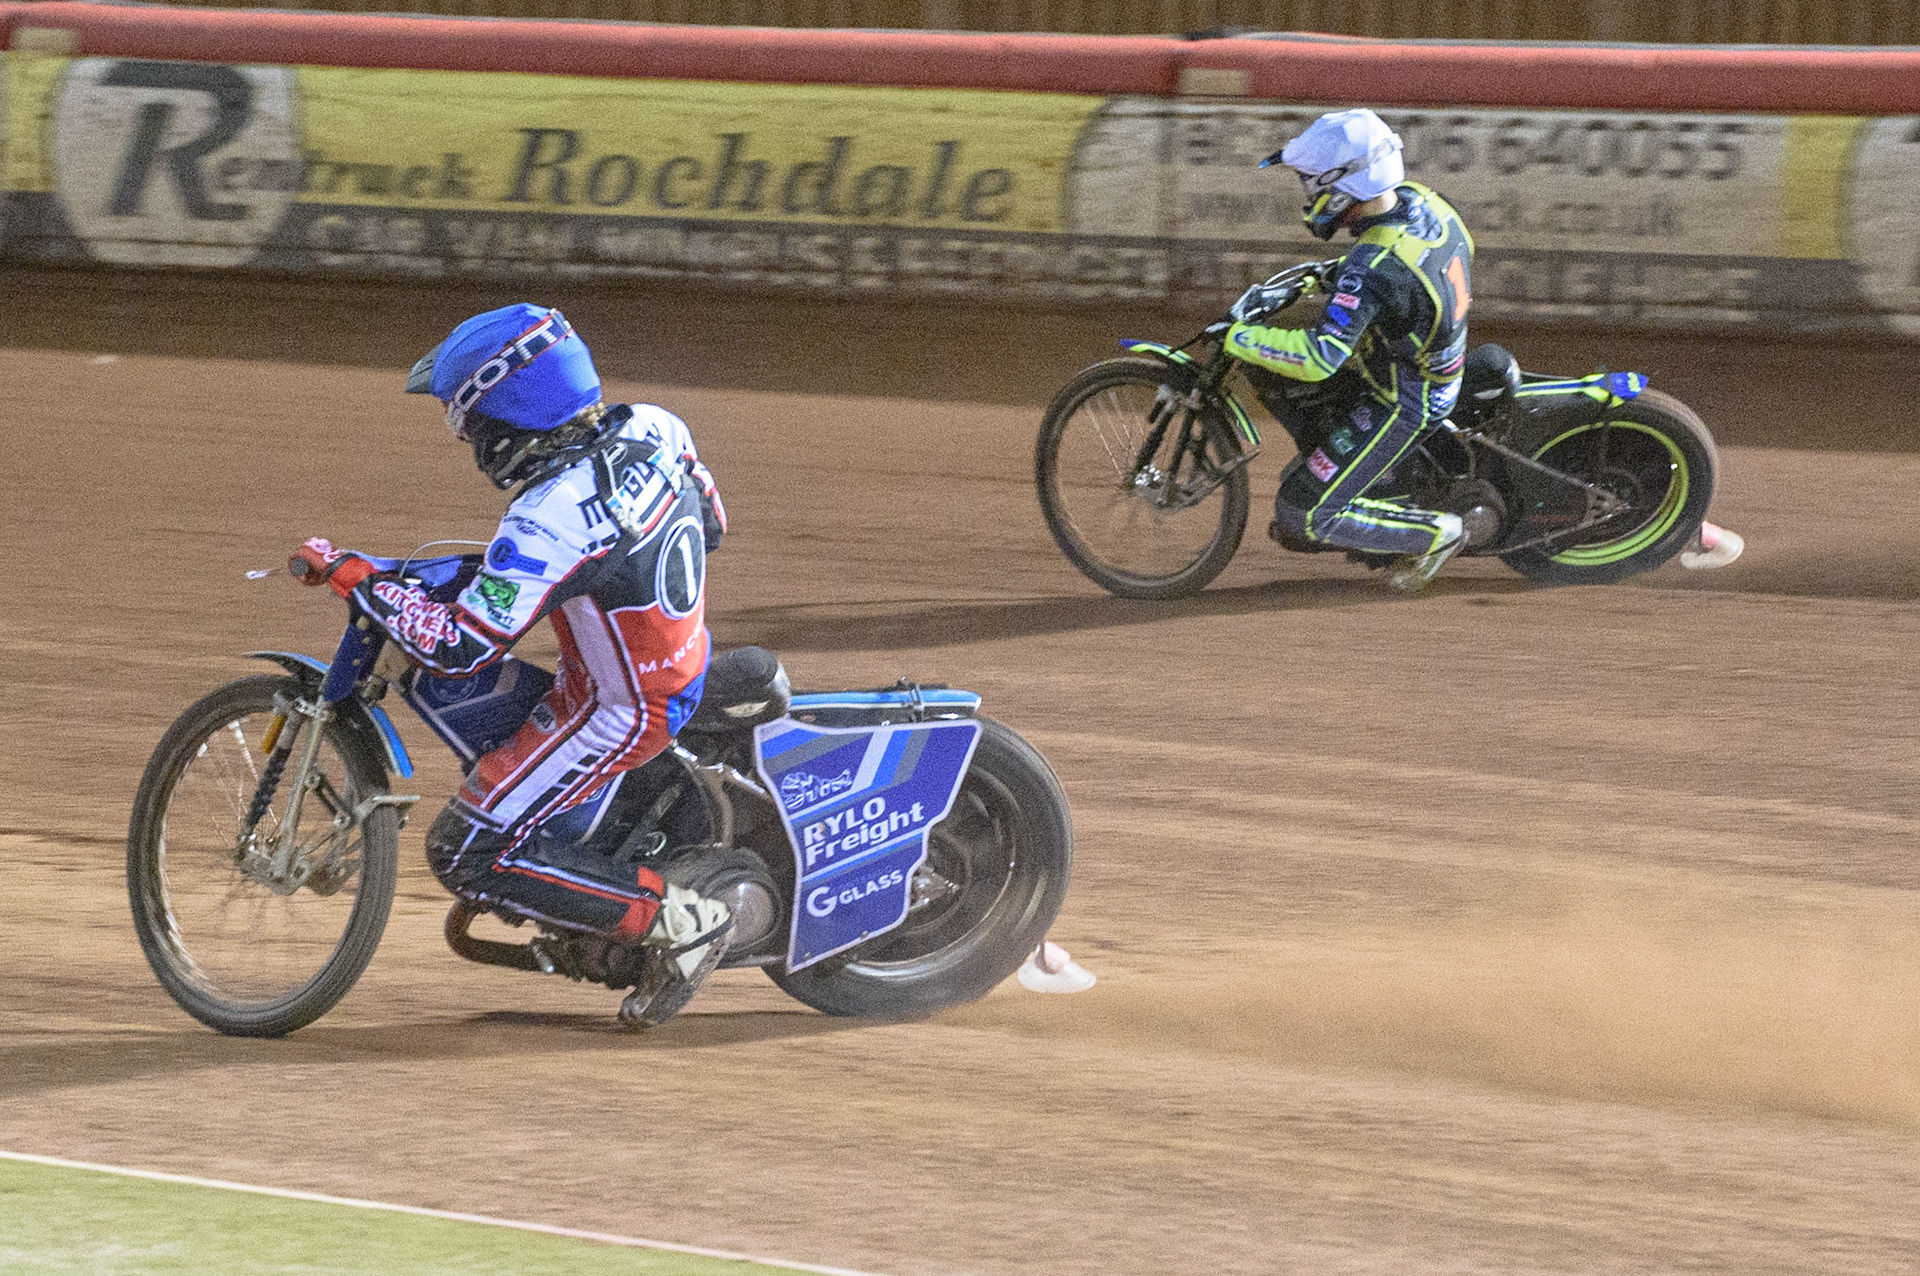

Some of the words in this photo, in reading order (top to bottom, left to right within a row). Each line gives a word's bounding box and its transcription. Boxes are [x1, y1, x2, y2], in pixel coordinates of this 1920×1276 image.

[503, 126, 1015, 224] Rochdale
[677, 533, 697, 606] 1
[803, 796, 886, 847] RYLO
[805, 801, 925, 868] Freight
[806, 886, 839, 918] G
[838, 869, 904, 905] GLASS
